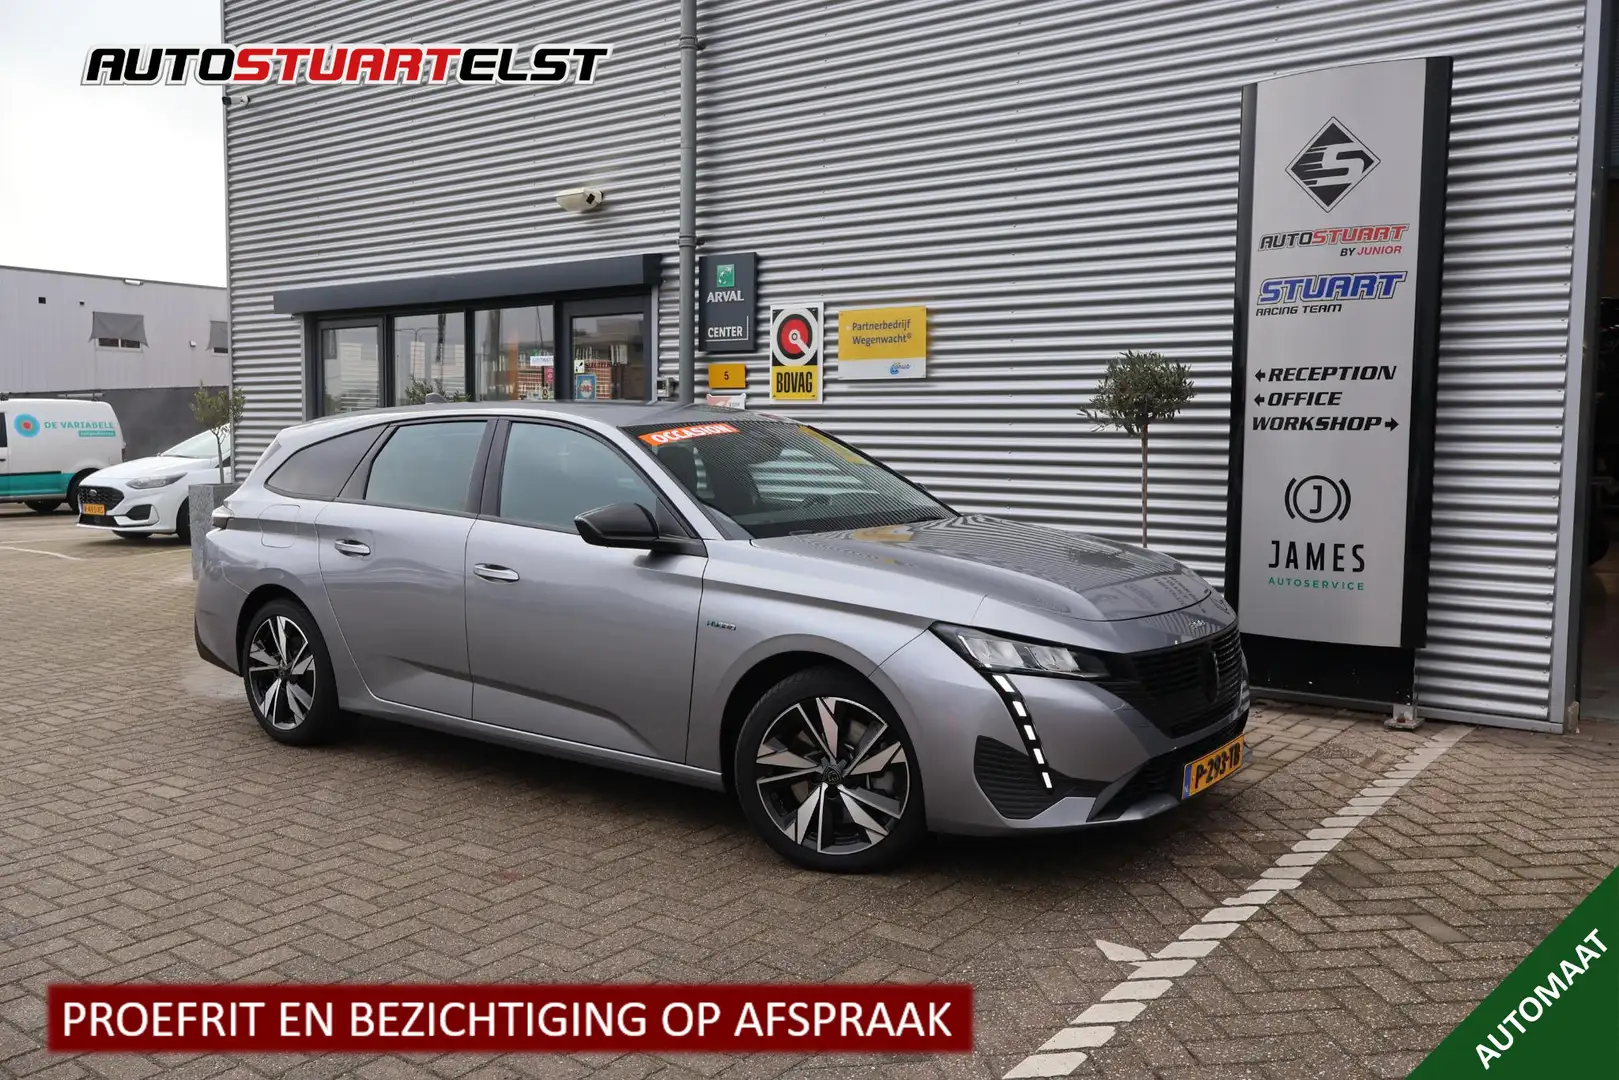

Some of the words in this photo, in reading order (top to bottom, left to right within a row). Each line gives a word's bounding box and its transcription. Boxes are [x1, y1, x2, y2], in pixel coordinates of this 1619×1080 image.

[1259, 225, 1408, 250] AUTOSTUART
[1340, 248, 1356, 257] BY
[1357, 245, 1402, 256] JUNIOR
[1258, 272, 1407, 304] STUART
[706, 290, 744, 303] ARVAL
[1256, 306, 1298, 317] RACING
[1302, 303, 1342, 314] TEAM
[707, 325, 743, 338] CENTER
[852, 318, 911, 331] Partnerbedrijf
[724, 371, 730, 380] 5
[1268, 365, 1397, 382] RECEPTION
[776, 371, 813, 394] BOVAG
[1267, 391, 1343, 406] OFFICE
[44, 421, 58, 429] DE
[1252, 416, 1382, 431] WORKSHOP
[651, 422, 733, 443] OCCASION
[1268, 540, 1365, 573] JAMES
[1268, 576, 1364, 591] AUTOSERVICE
